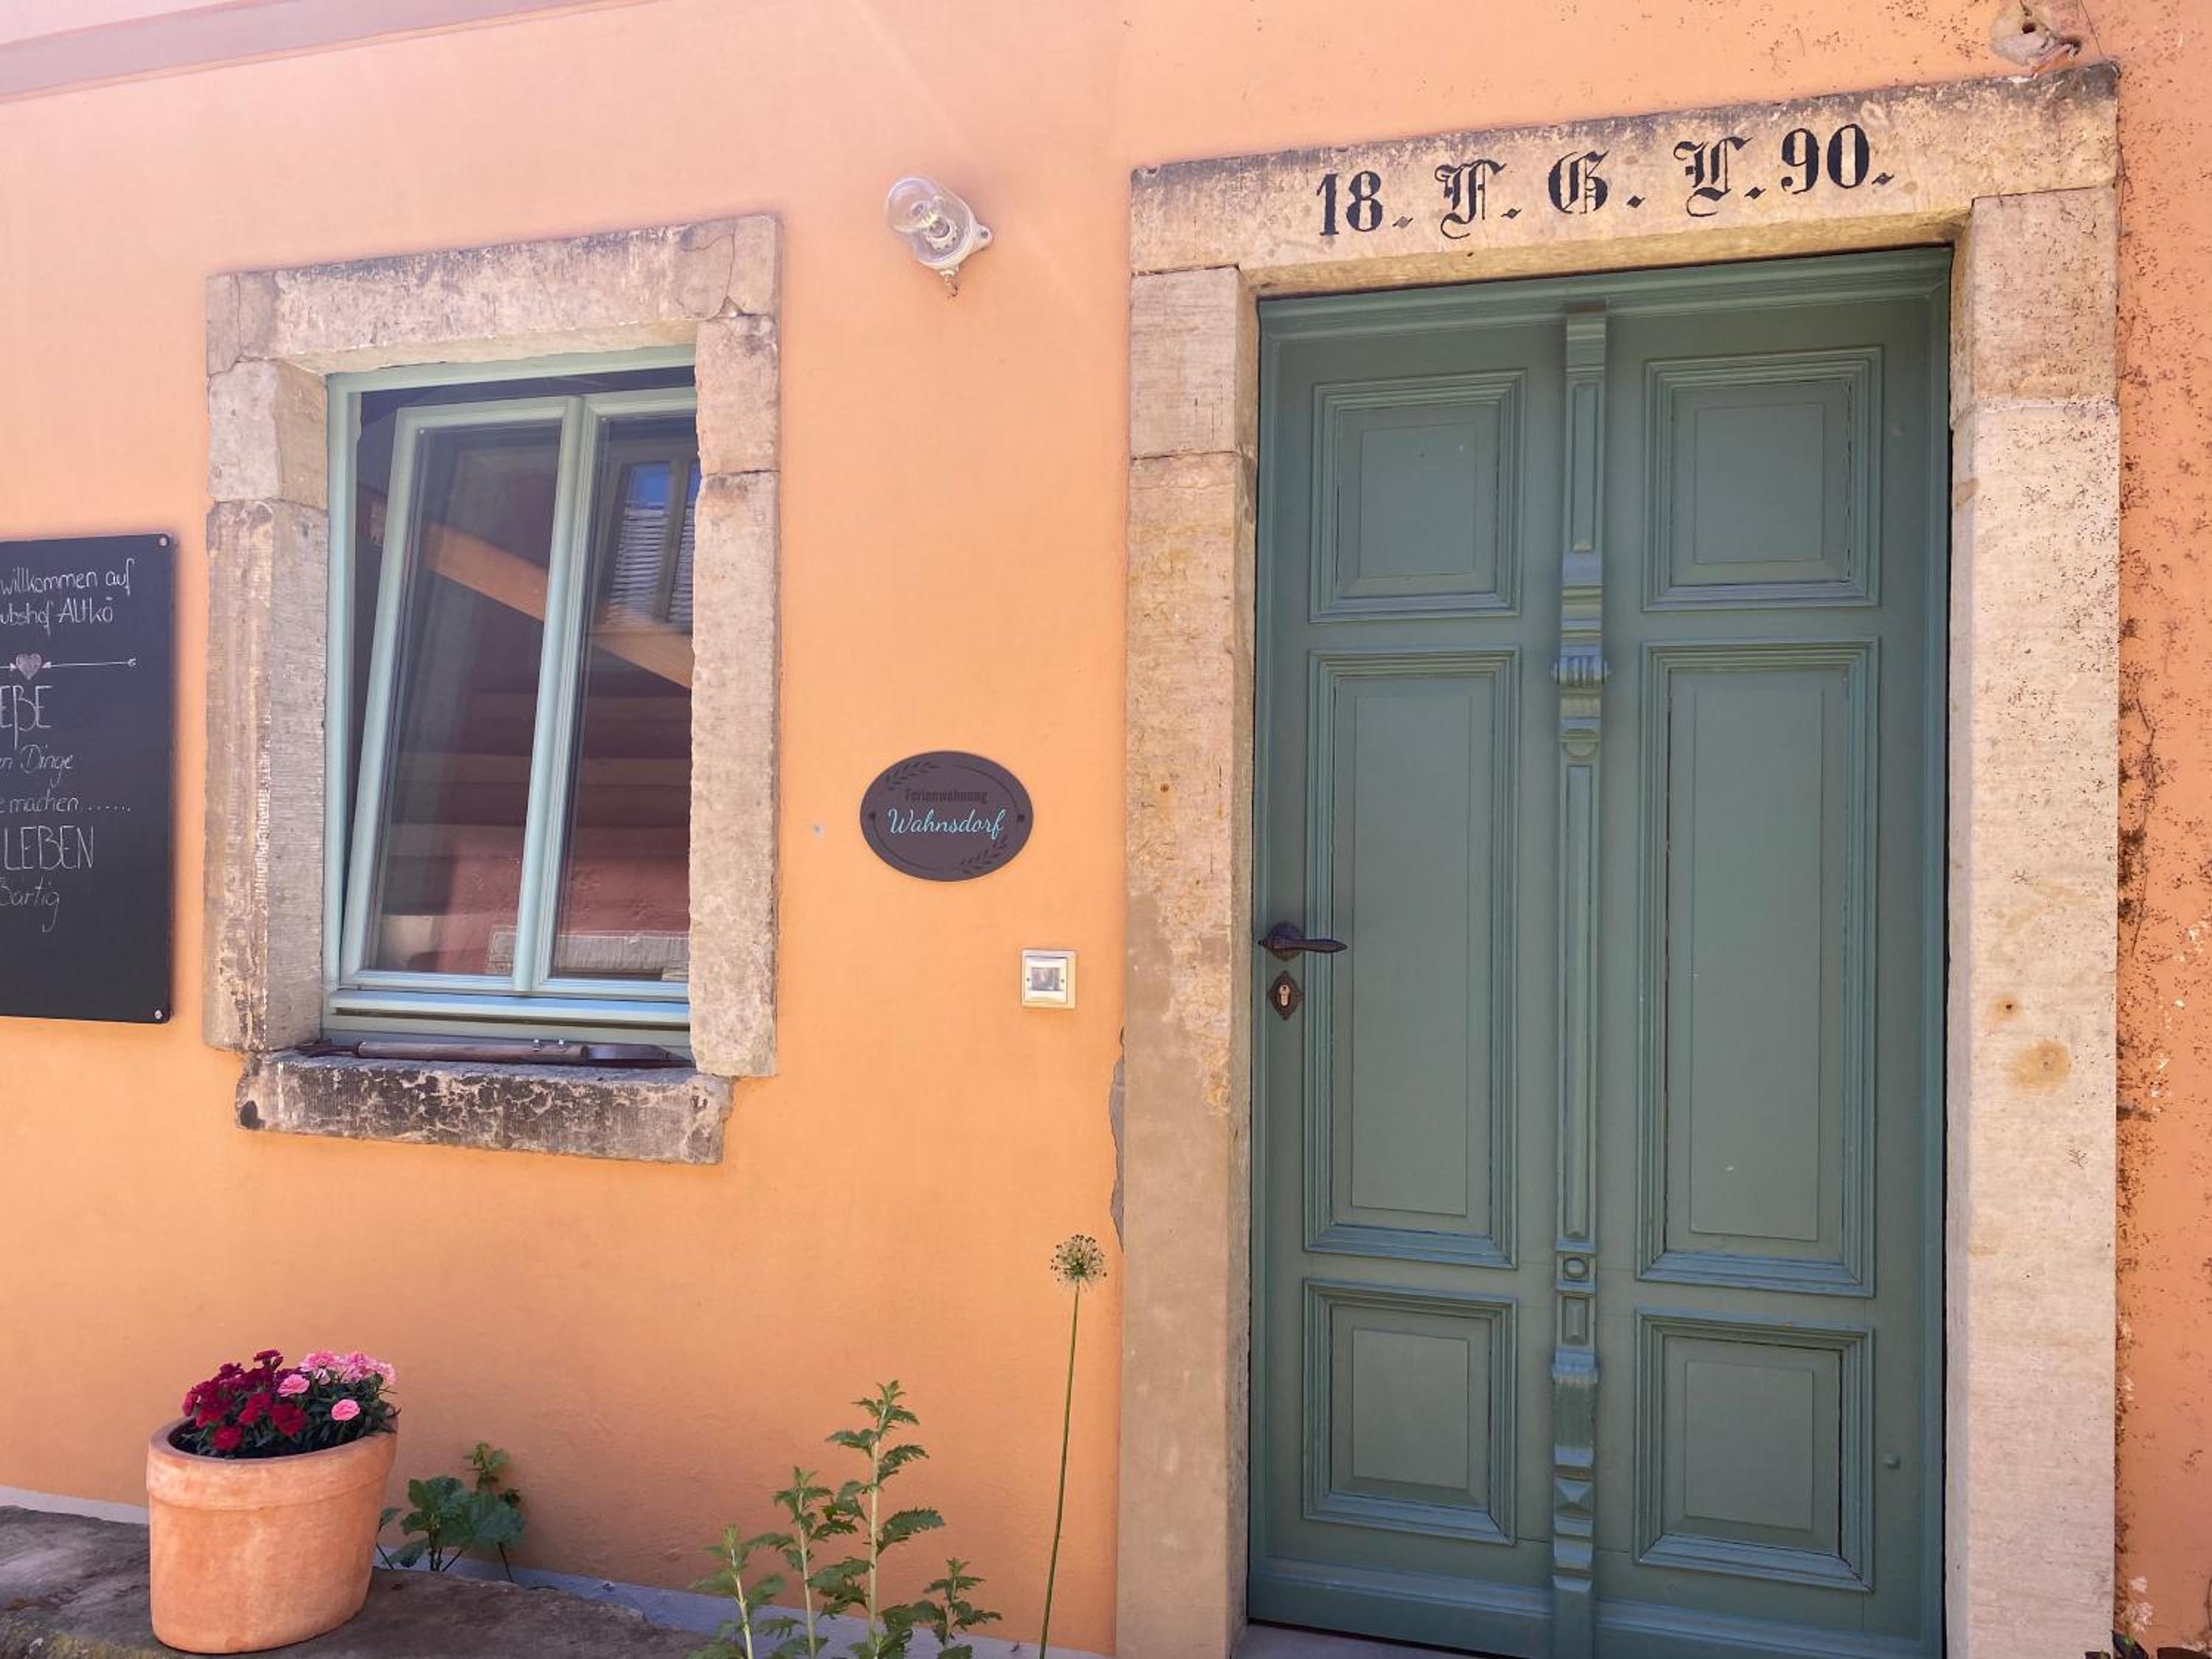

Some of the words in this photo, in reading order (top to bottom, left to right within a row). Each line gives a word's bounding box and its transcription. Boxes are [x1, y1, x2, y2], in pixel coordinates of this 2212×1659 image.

[105, 558, 135, 596] auf
[18, 744, 74, 788] Dinge
[905, 789, 987, 804] Ferienwohnung
[887, 808, 1006, 841] Wahnsdorf
[4, 825, 94, 871] LEBEN
